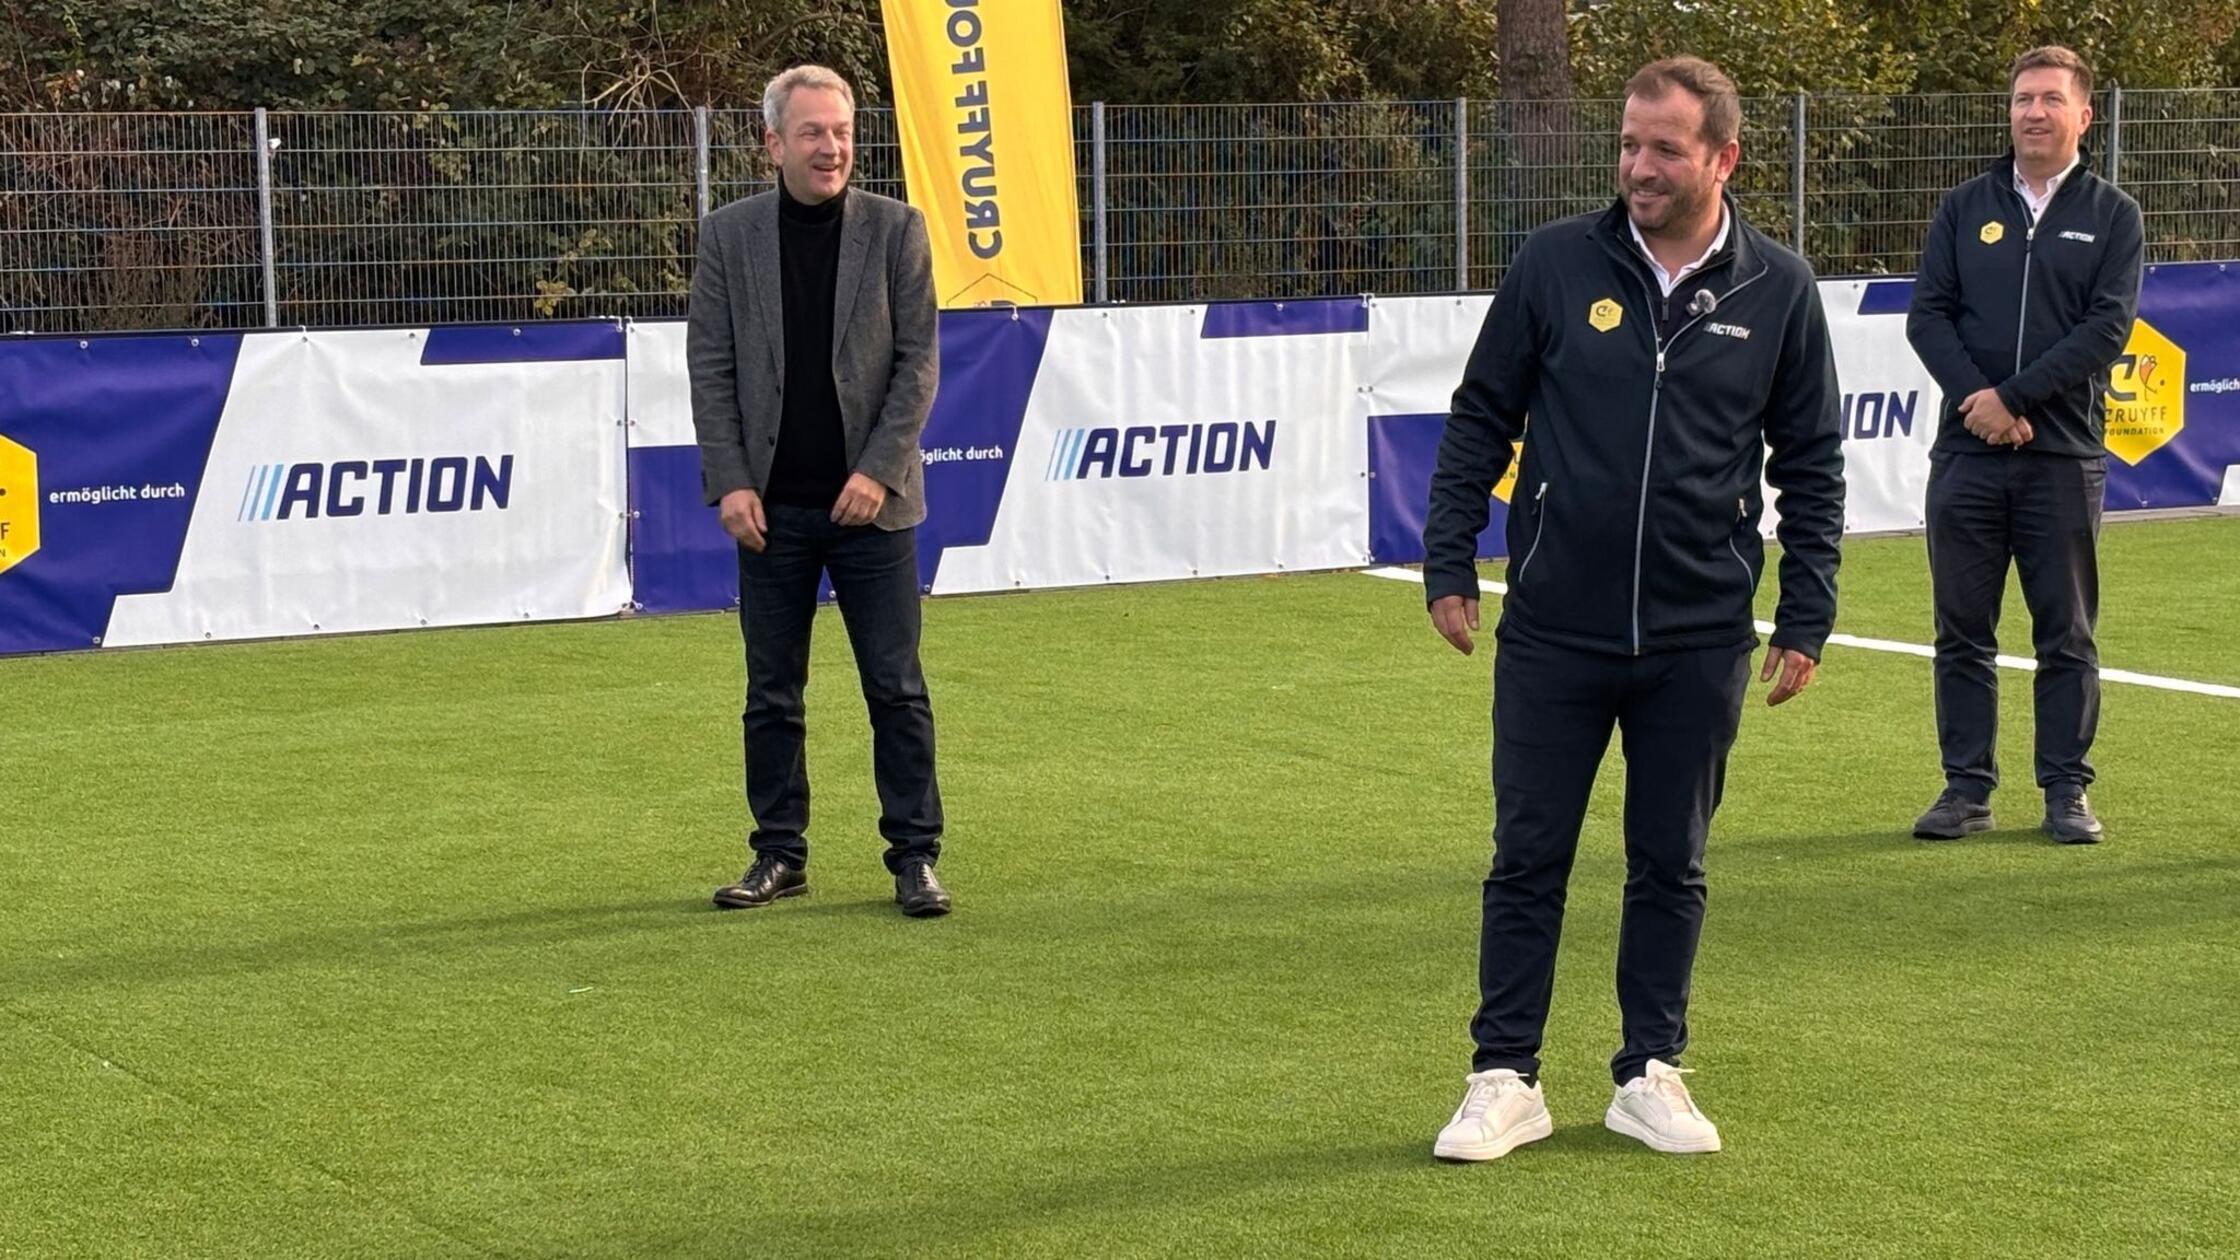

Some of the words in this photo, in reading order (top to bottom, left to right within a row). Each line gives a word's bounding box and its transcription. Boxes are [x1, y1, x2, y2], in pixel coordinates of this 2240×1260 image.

[1708, 322, 1751, 340] ACTION
[2190, 378, 2240, 395] ermöglich
[1840, 390, 1919, 441] ION
[2105, 426, 2165, 437] OUNDATION
[920, 446, 964, 466] öglicht
[965, 444, 1004, 461] durch
[1075, 419, 1277, 480] ACTION
[49, 484, 137, 505] ermöglicht
[140, 482, 186, 499] durch
[276, 453, 515, 521] ACTION
